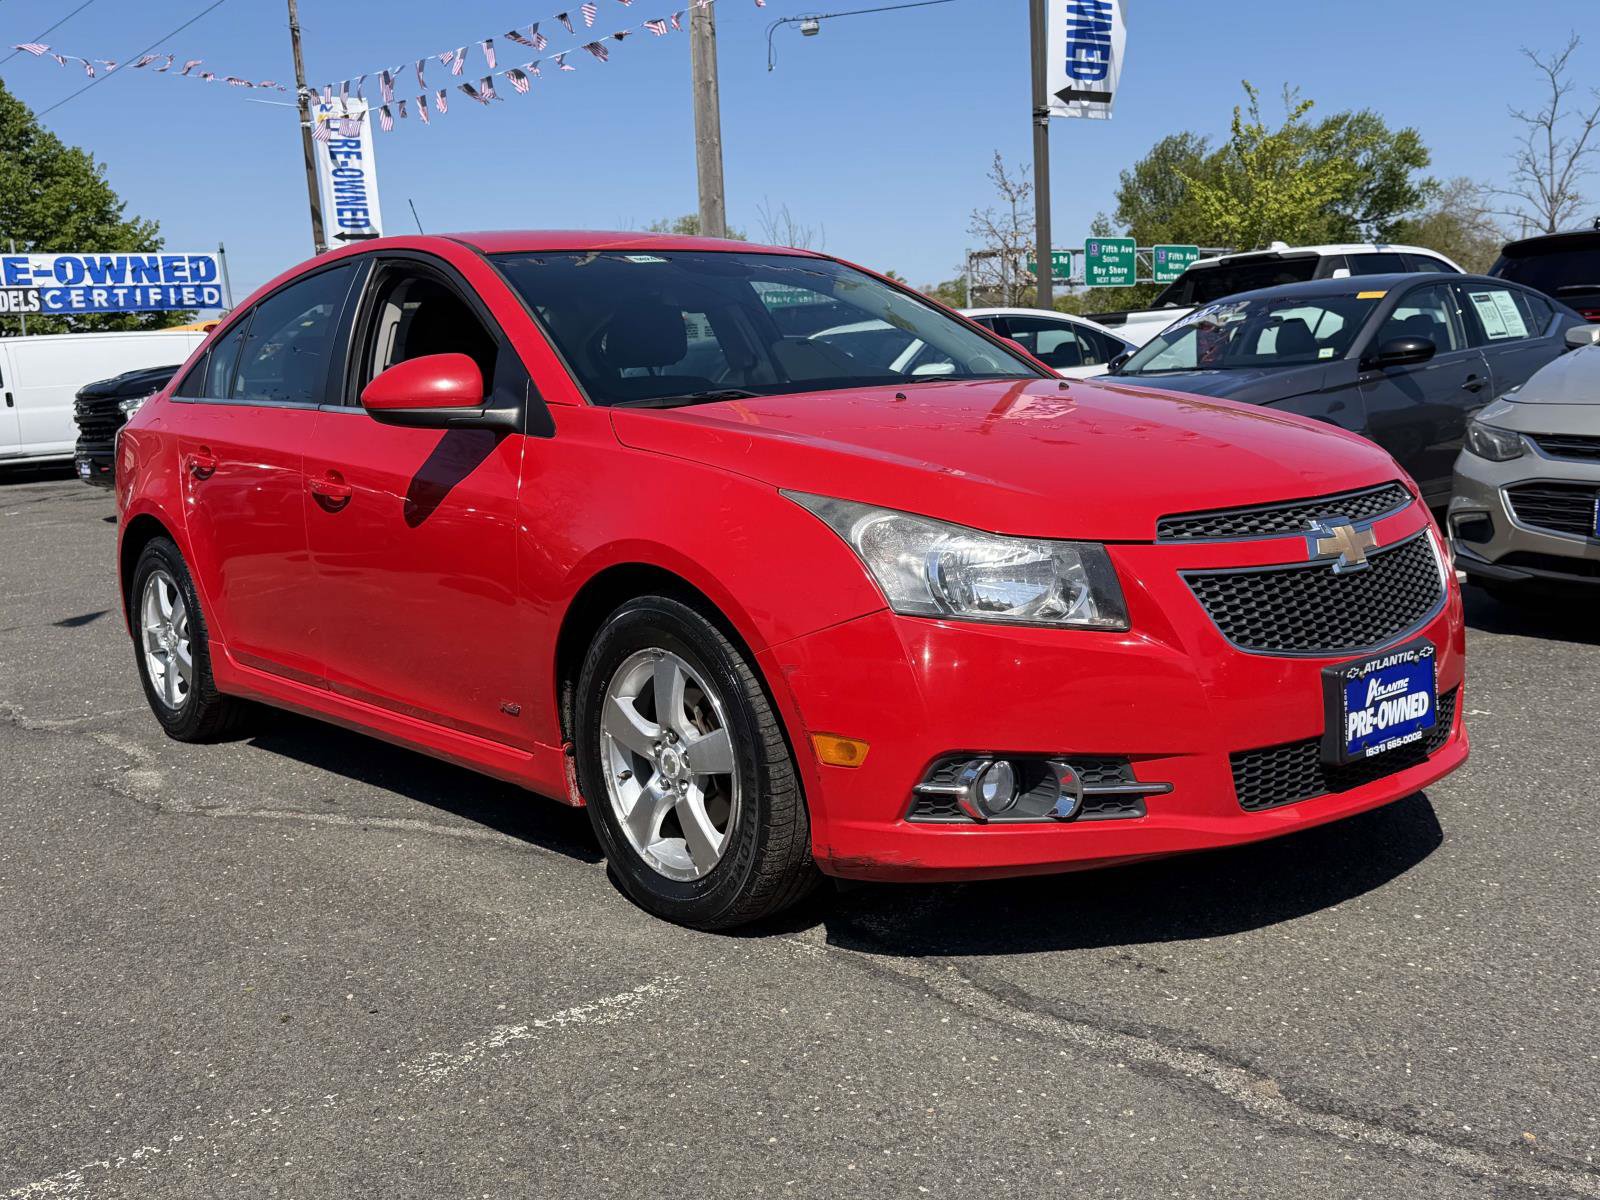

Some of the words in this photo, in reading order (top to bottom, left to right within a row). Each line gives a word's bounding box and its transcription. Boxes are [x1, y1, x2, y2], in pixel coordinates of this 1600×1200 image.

[1059, 255, 1068, 264] Rd
[1101, 245, 1118, 253] Fifth
[1120, 245, 1133, 253] Ave
[1168, 252, 1184, 261] Fifth
[1186, 252, 1198, 261] Ave
[0, 255, 217, 286] E-OWNED
[1093, 266, 1106, 276] Bay
[1109, 266, 1128, 274] Shore
[0, 289, 40, 313] DELS
[45, 287, 220, 309] CERTIFIED
[1363, 650, 1415, 673] ATLANTIC
[1348, 690, 1429, 741] PRE-OWNED
[1365, 744, 1386, 757] (631)
[1387, 730, 1423, 750] 665-0002
